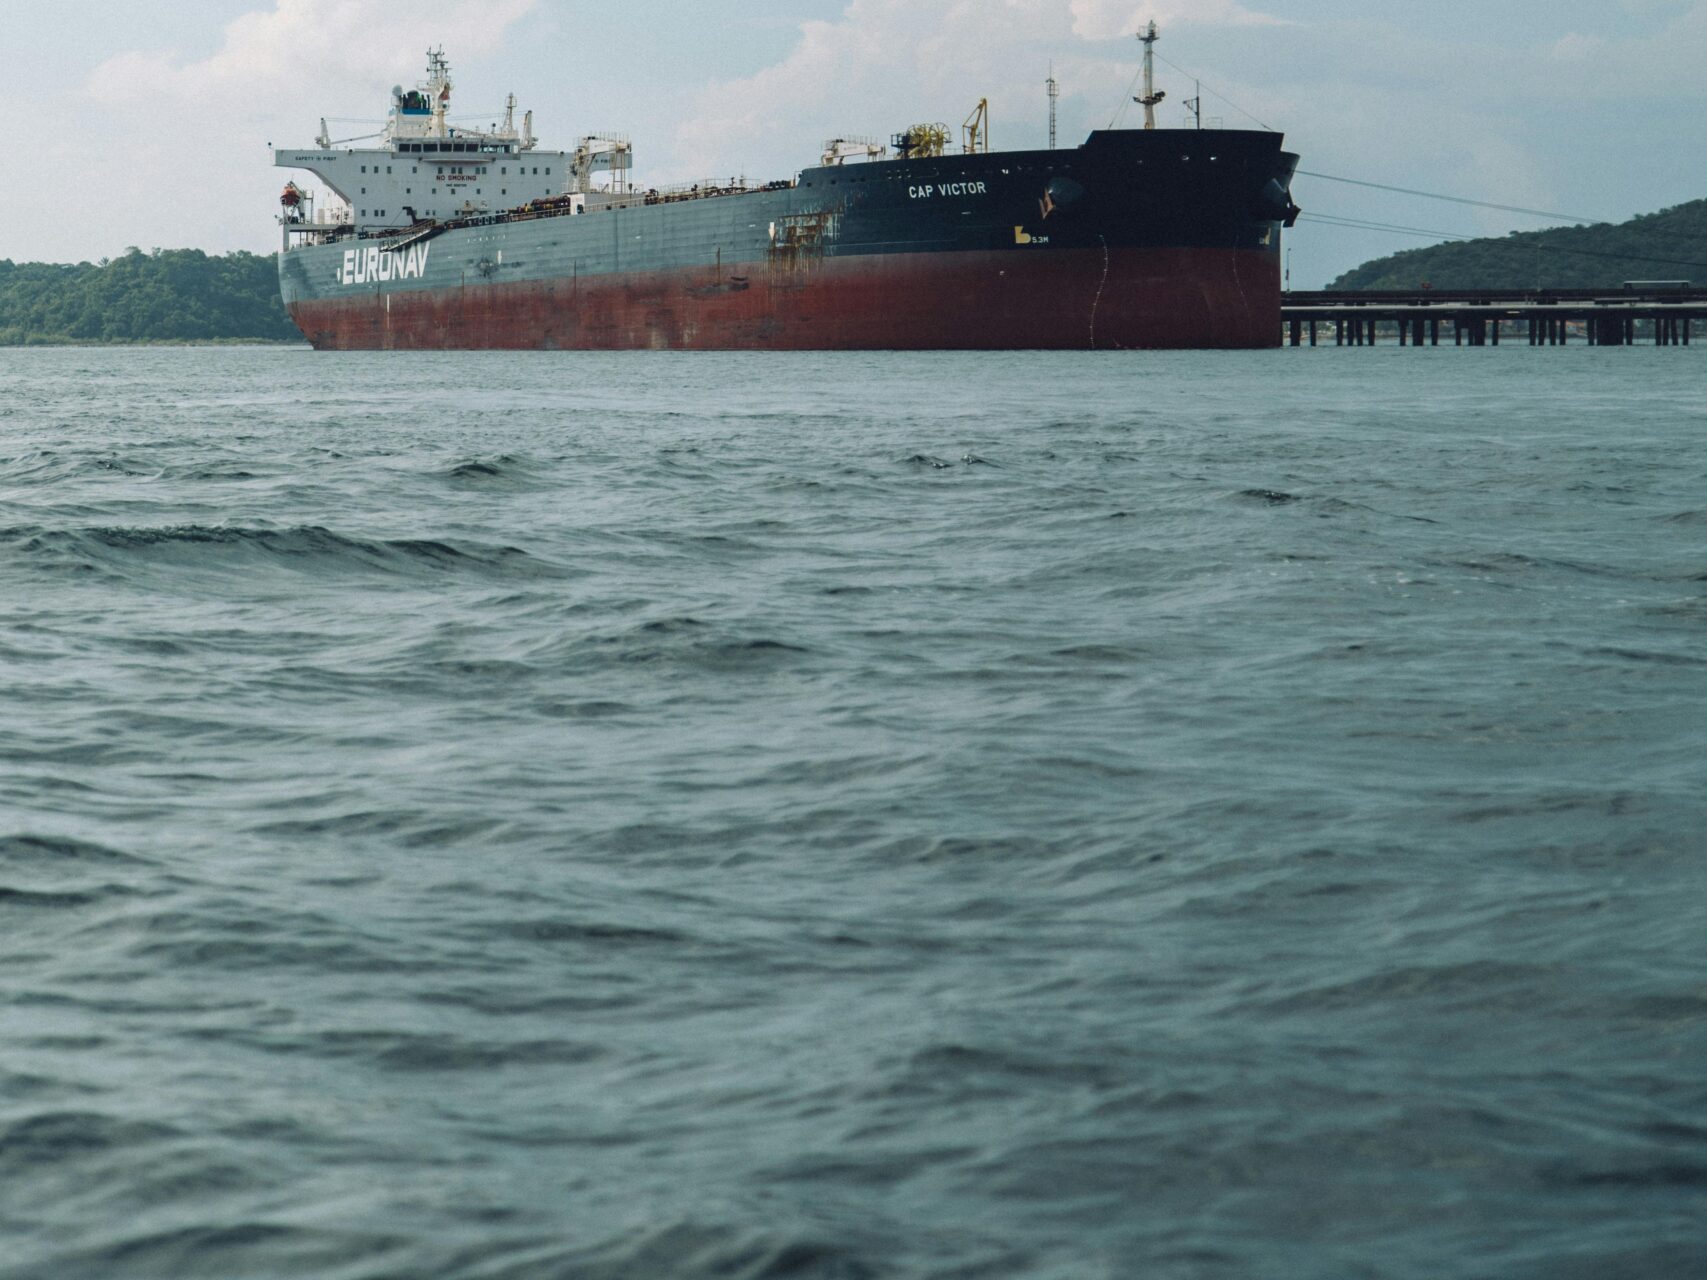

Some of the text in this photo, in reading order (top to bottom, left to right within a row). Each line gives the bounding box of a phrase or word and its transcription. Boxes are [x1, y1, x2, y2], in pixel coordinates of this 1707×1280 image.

[908, 181, 986, 198] CAP VICTOR
[343, 240, 431, 285] EURONAV
